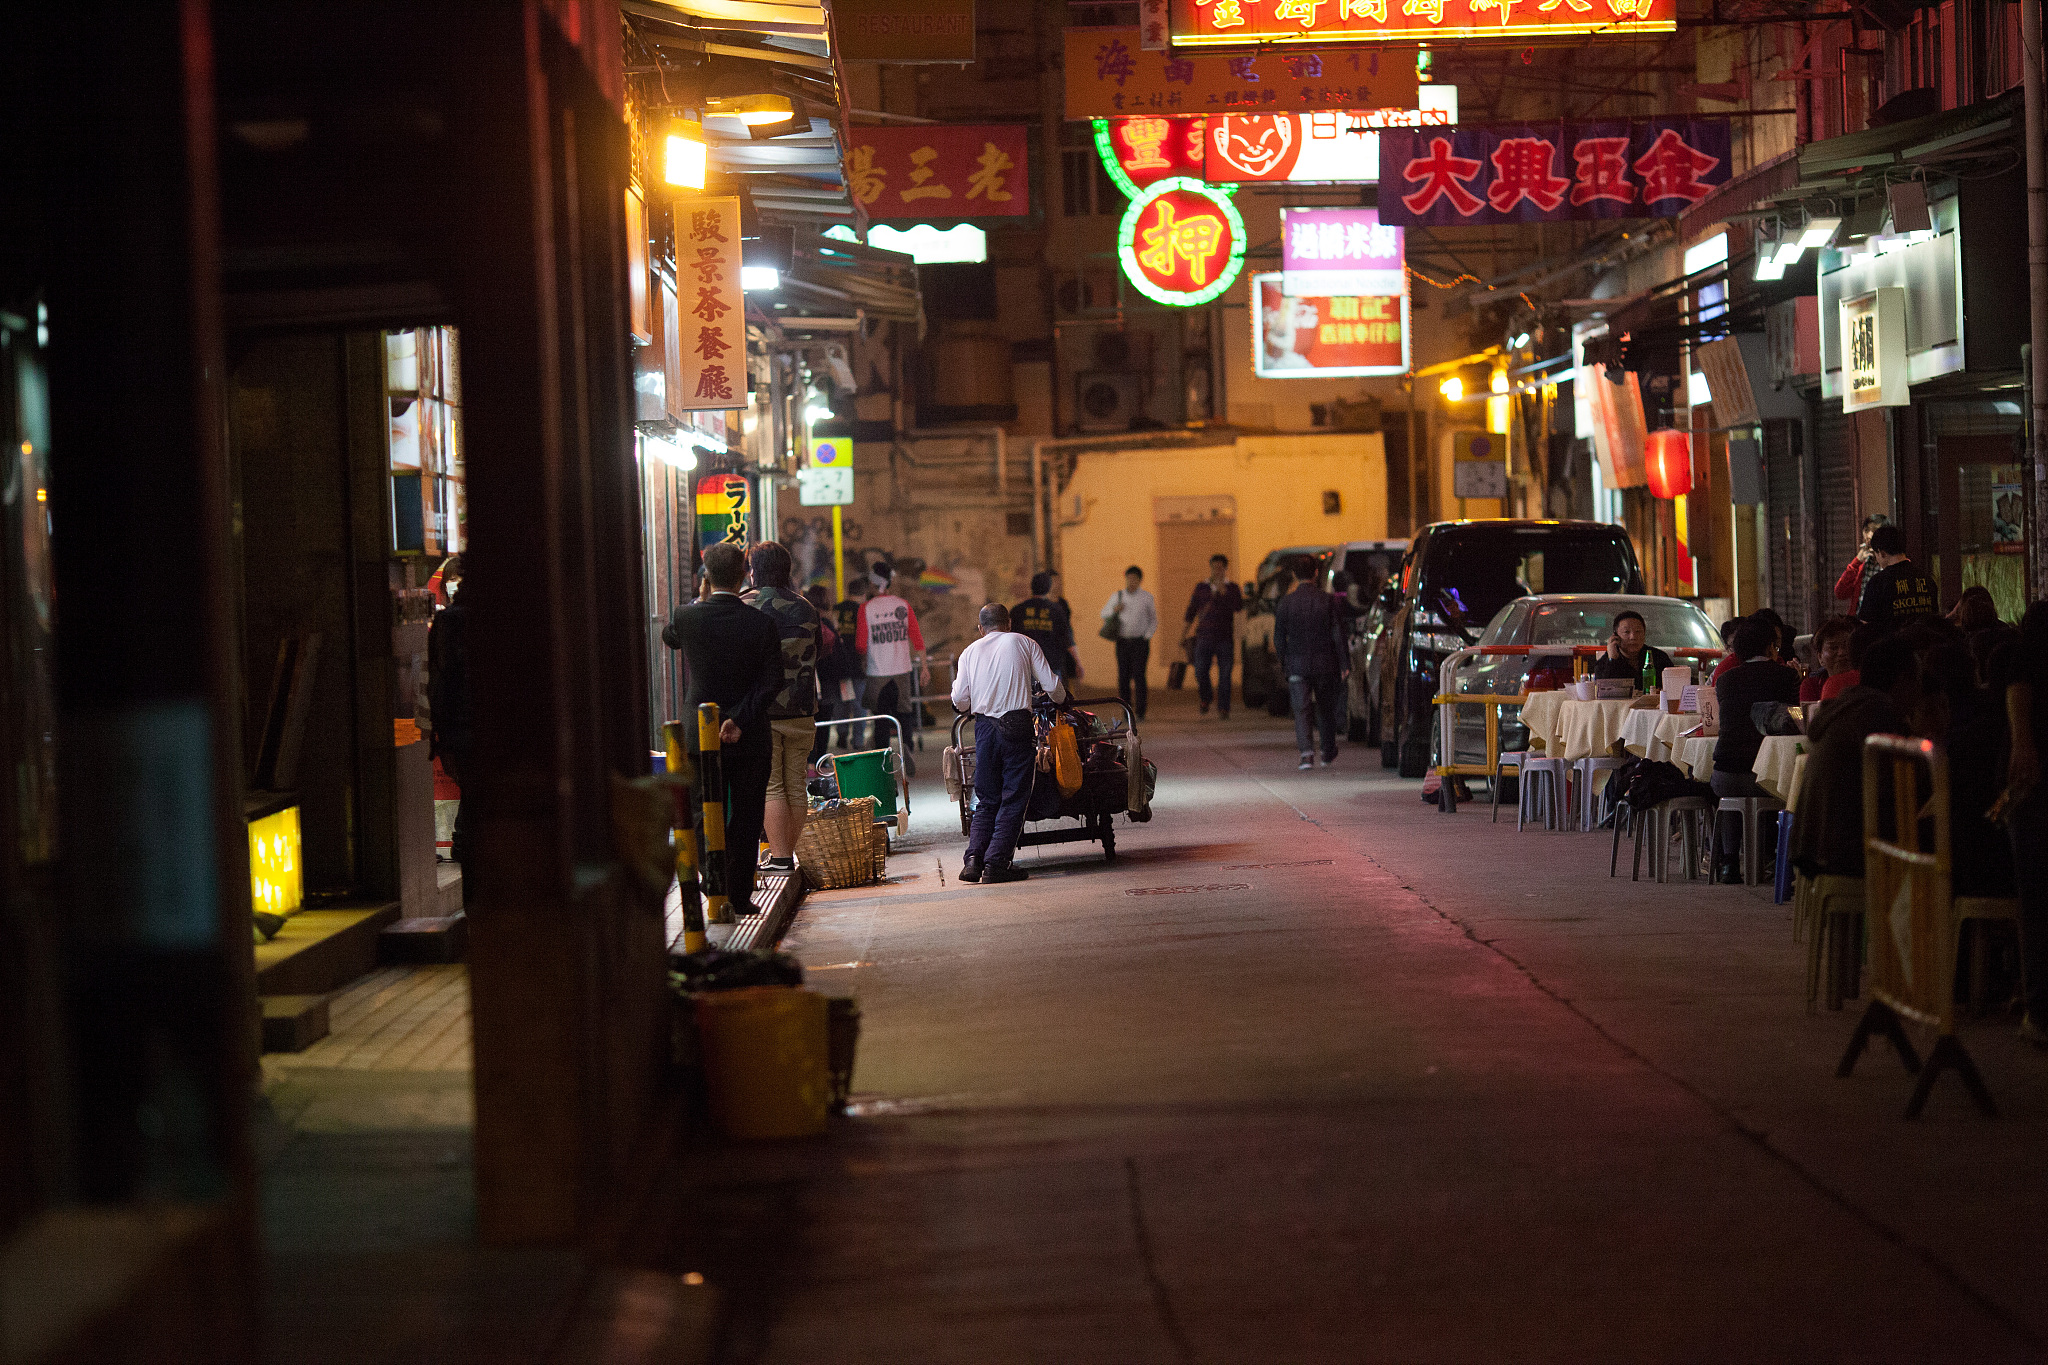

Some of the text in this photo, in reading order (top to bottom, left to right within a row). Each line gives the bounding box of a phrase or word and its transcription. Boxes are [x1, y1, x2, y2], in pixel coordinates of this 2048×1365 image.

[858, 14, 969, 34] RESTAURANT
[1402, 129, 1720, 216] 大興五金
[1139, 200, 1223, 285] 押
[690, 208, 733, 400] 駿景茶餐廳
[724, 481, 748, 552] ラーメ
